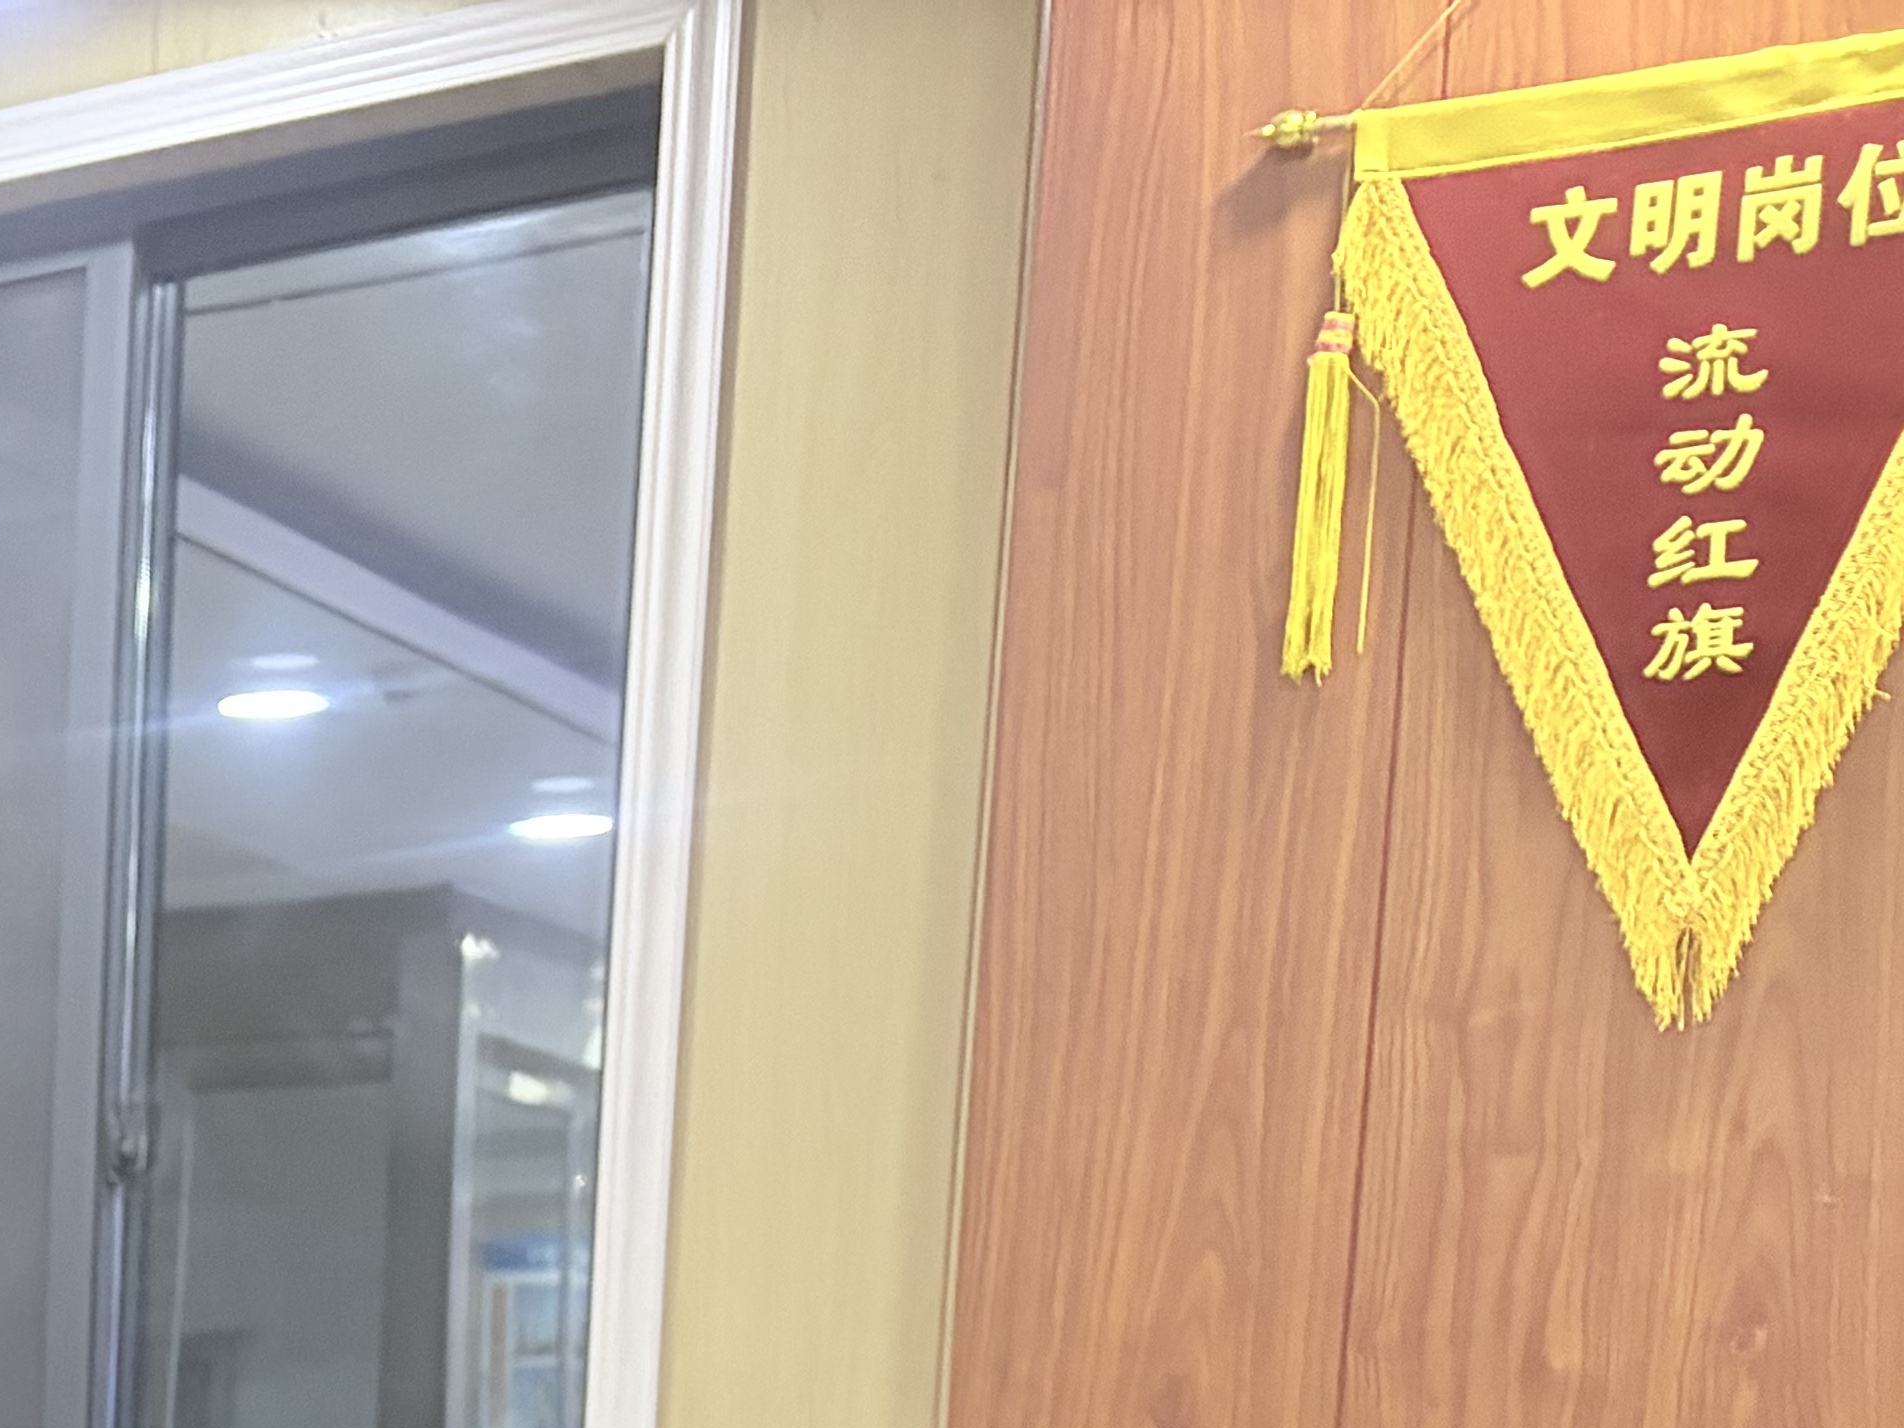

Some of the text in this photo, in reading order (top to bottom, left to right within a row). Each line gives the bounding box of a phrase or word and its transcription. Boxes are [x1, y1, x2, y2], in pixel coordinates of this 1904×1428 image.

[1520, 138, 1904, 289] 文明岗位
[1642, 322, 1770, 683] 流动红旗
